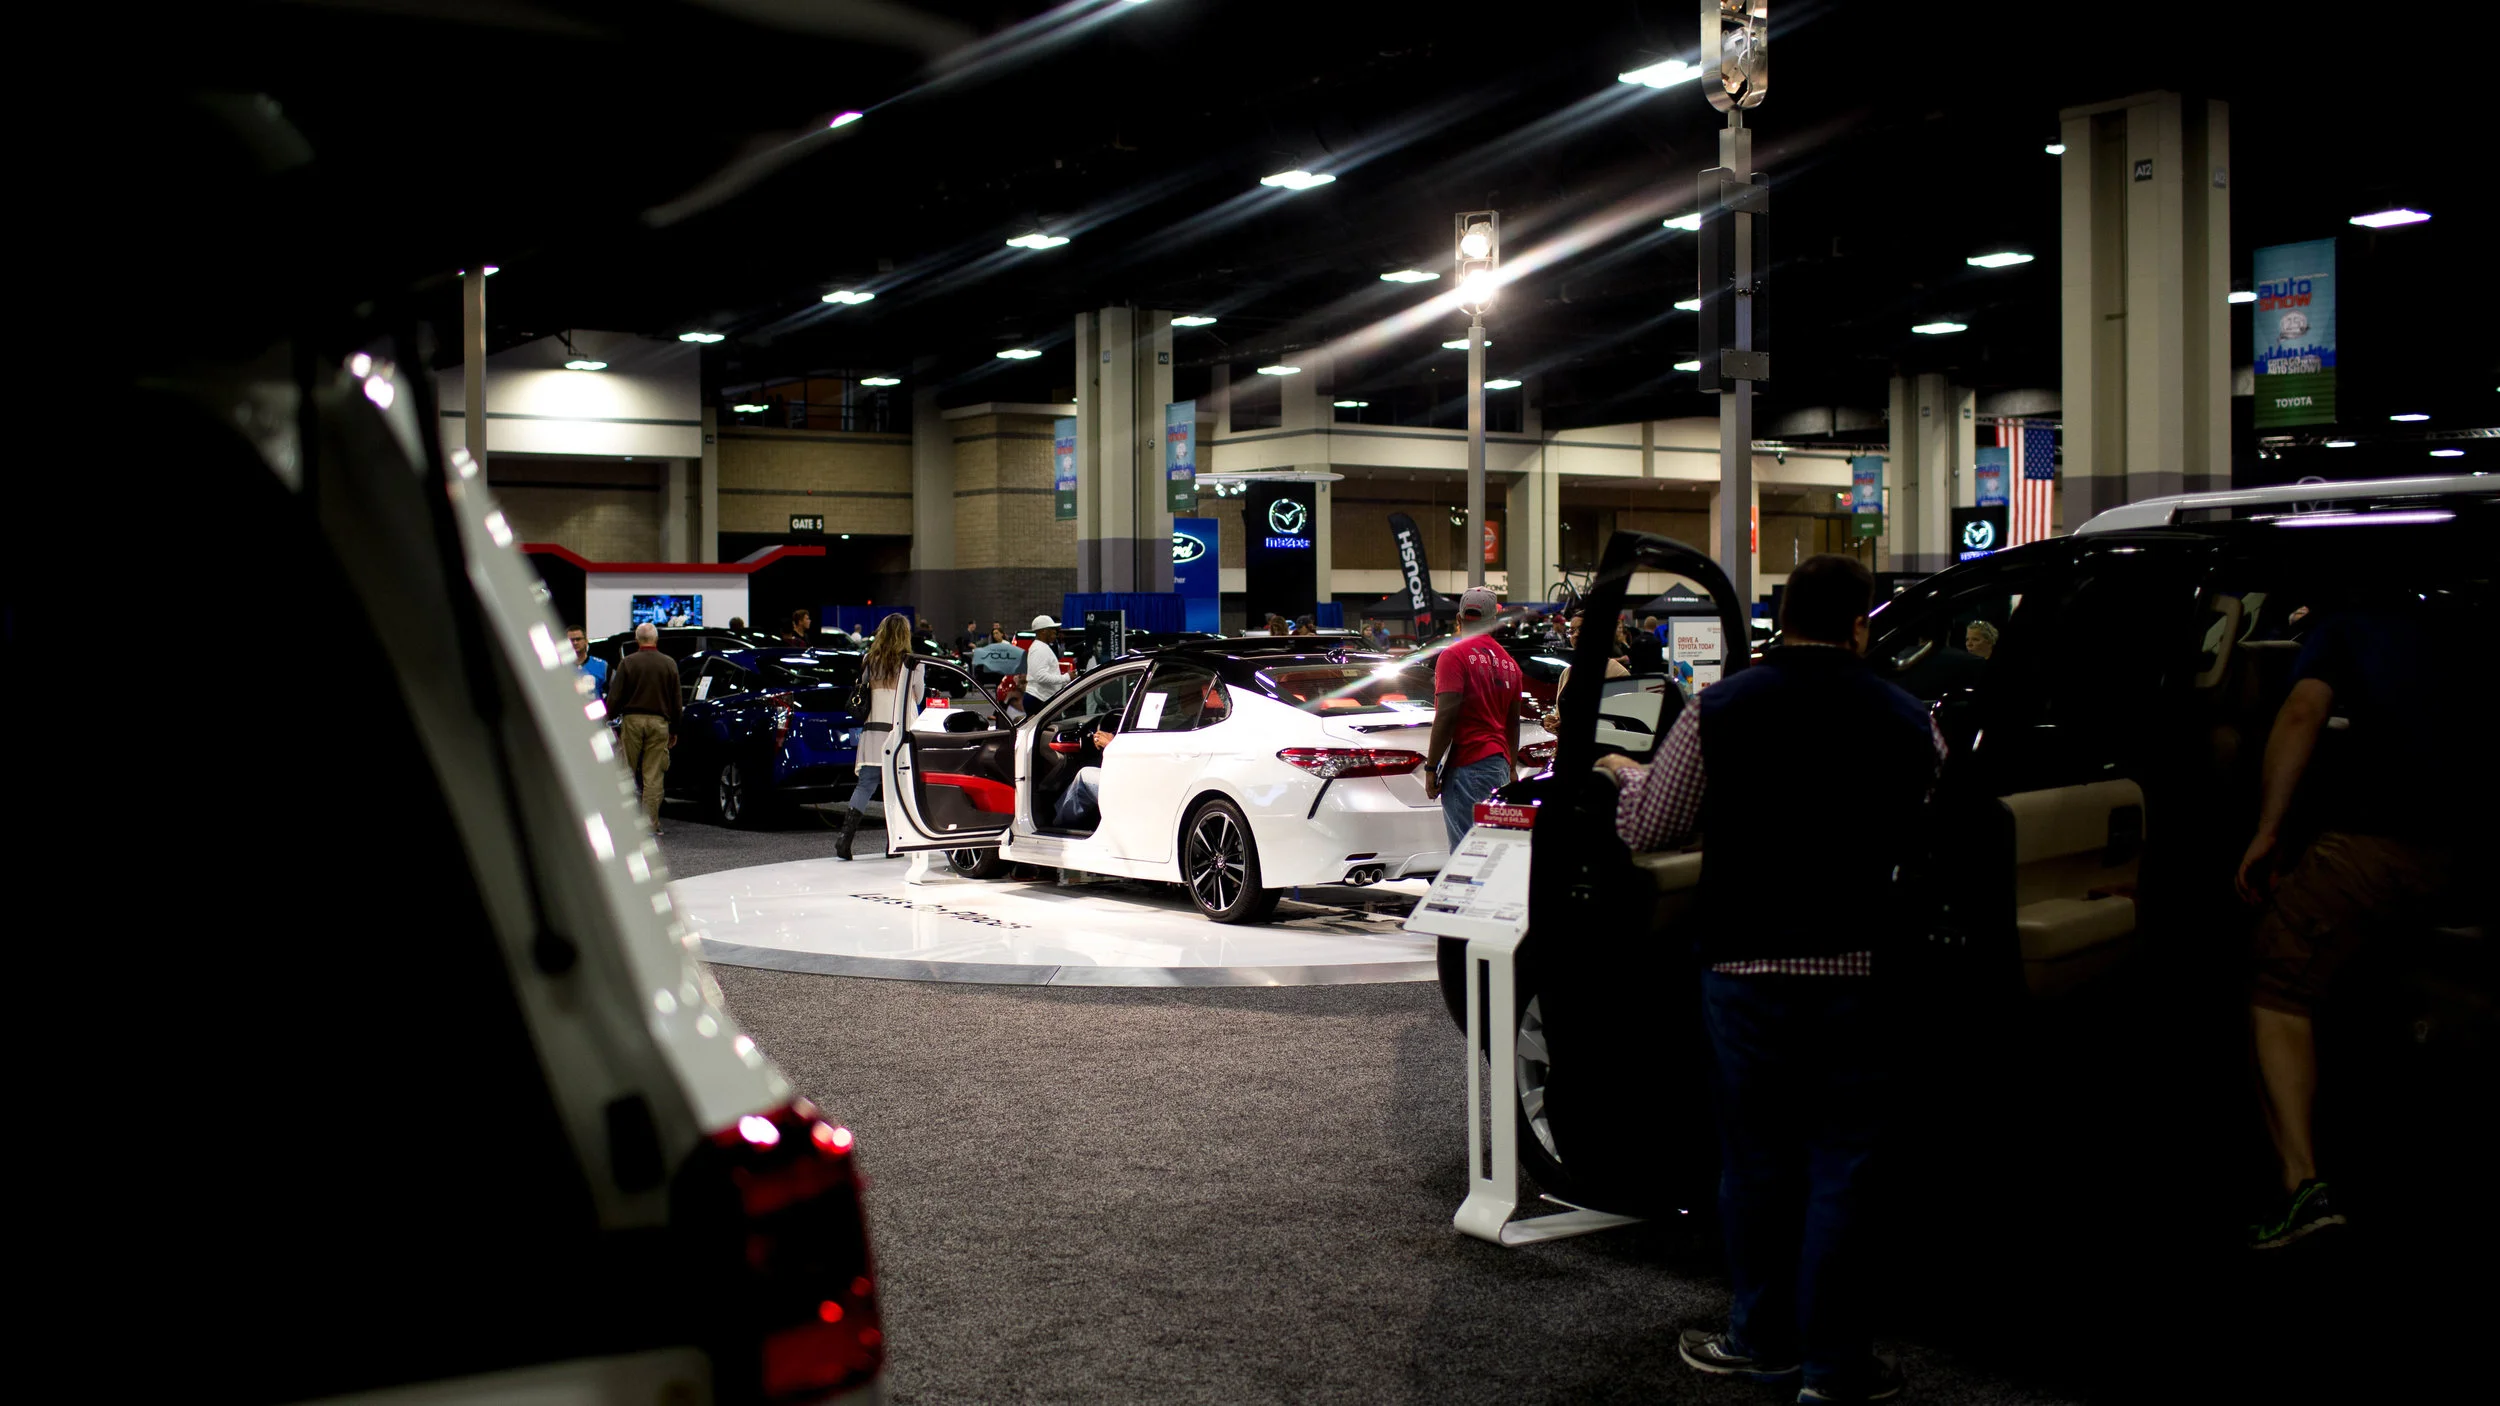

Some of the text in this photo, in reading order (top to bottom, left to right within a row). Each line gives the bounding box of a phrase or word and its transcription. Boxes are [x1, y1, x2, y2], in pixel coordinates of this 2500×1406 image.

[2135, 164, 2152, 177] A12
[2259, 277, 2312, 298] auto
[2259, 292, 2312, 312] show
[2275, 396, 2313, 408] TOYOTA
[792, 518, 823, 529] GATE 5
[1398, 530, 1425, 610] ROUSH
[1489, 807, 1524, 817] SEQUOIA
